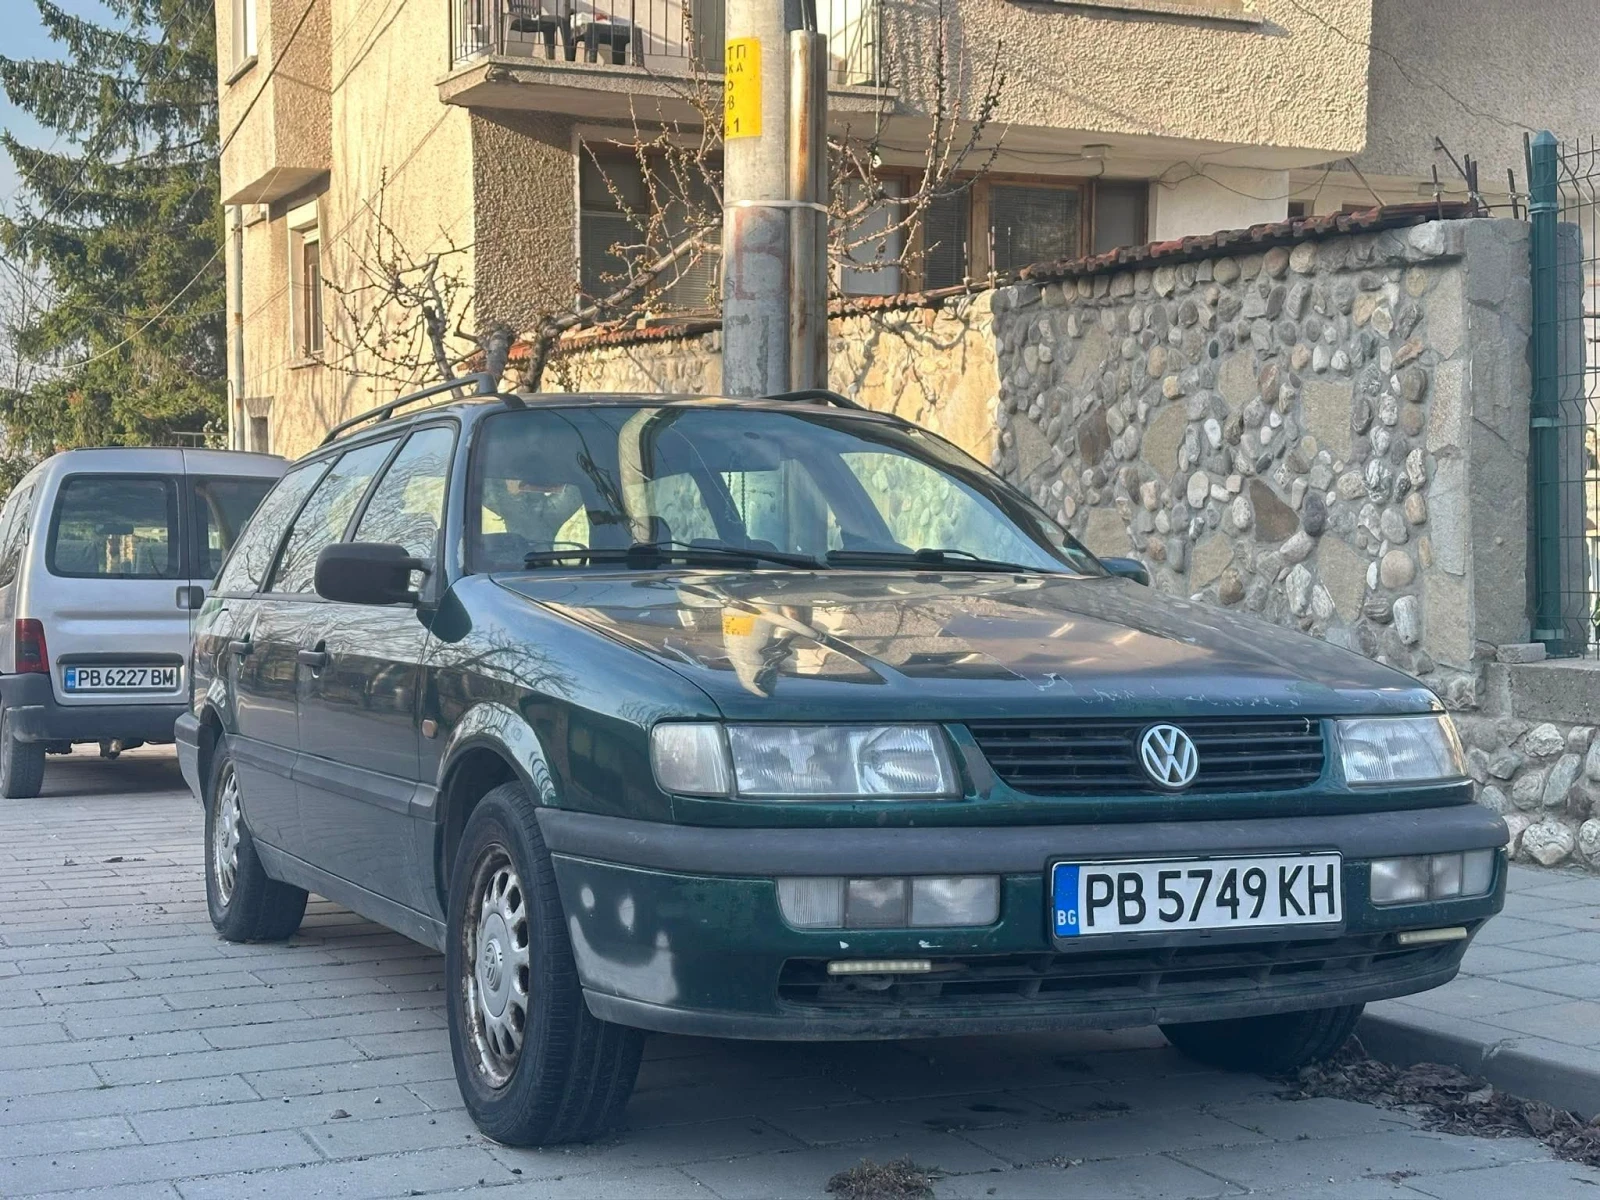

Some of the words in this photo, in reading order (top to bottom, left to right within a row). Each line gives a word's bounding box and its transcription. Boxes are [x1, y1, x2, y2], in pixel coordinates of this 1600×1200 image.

[78, 669, 101, 687] PB
[105, 669, 147, 686] 6227
[151, 669, 174, 686] BM
[1141, 724, 1198, 787] VW
[1086, 871, 1147, 927] PB
[1158, 867, 1267, 923] 5749
[1278, 864, 1335, 917] KH
[1057, 909, 1077, 926] BG
